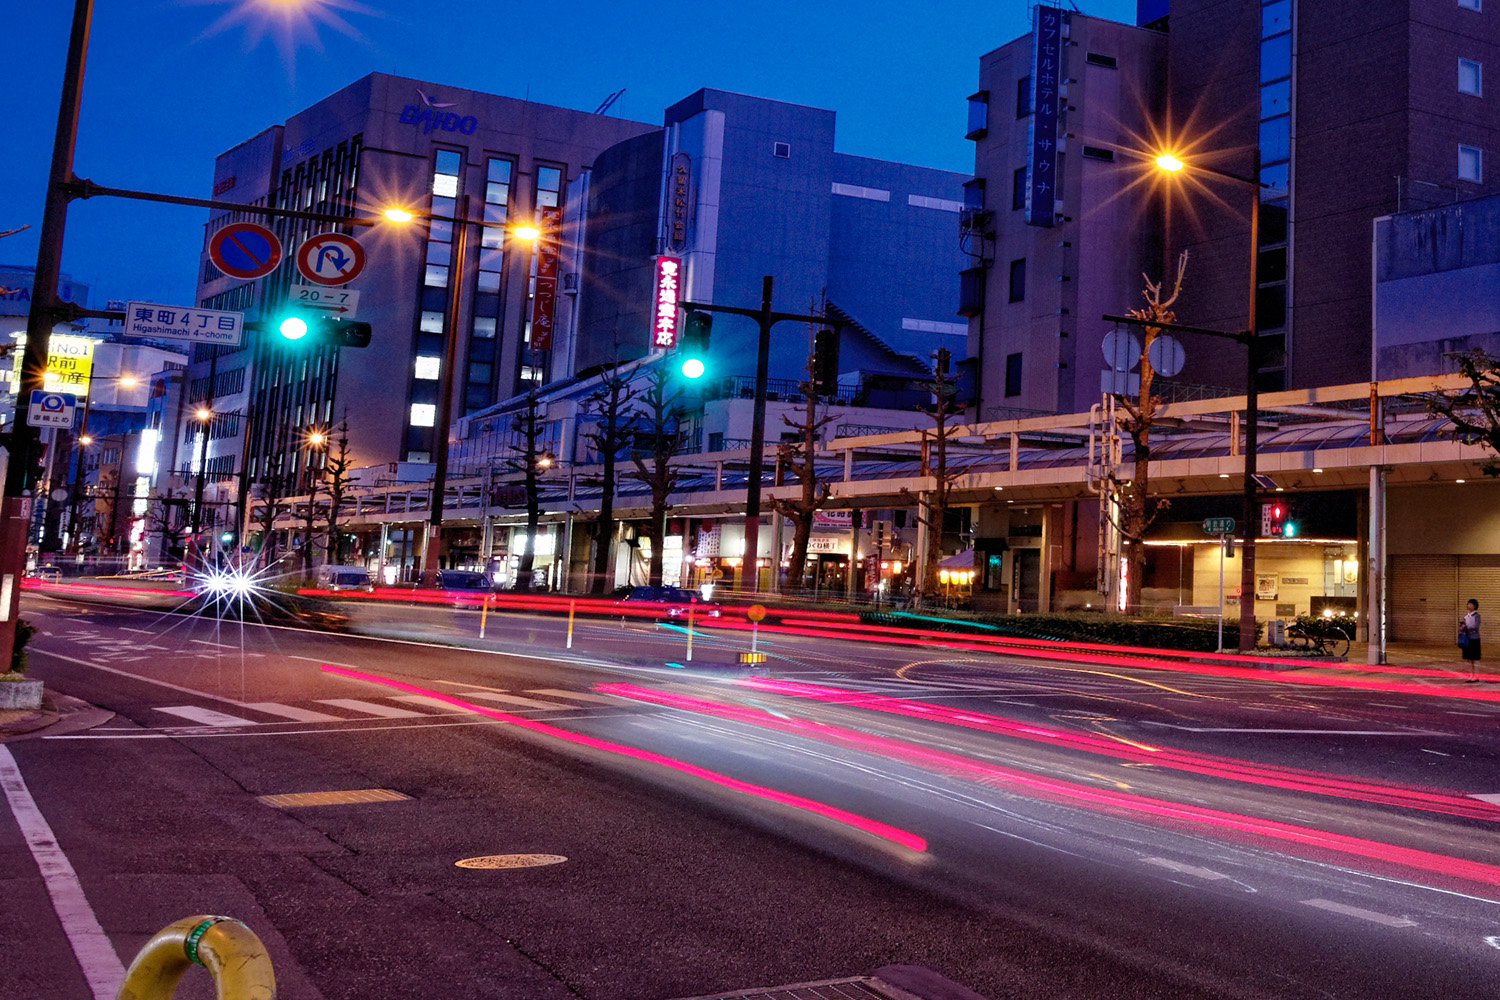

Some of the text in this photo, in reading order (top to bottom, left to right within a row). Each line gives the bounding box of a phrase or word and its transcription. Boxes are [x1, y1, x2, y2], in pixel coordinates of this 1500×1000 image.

[400, 104, 478, 135] DAIDO
[133, 307, 235, 331] 東町4丁目
[133, 324, 233, 340] Higashimachi 4-chome
